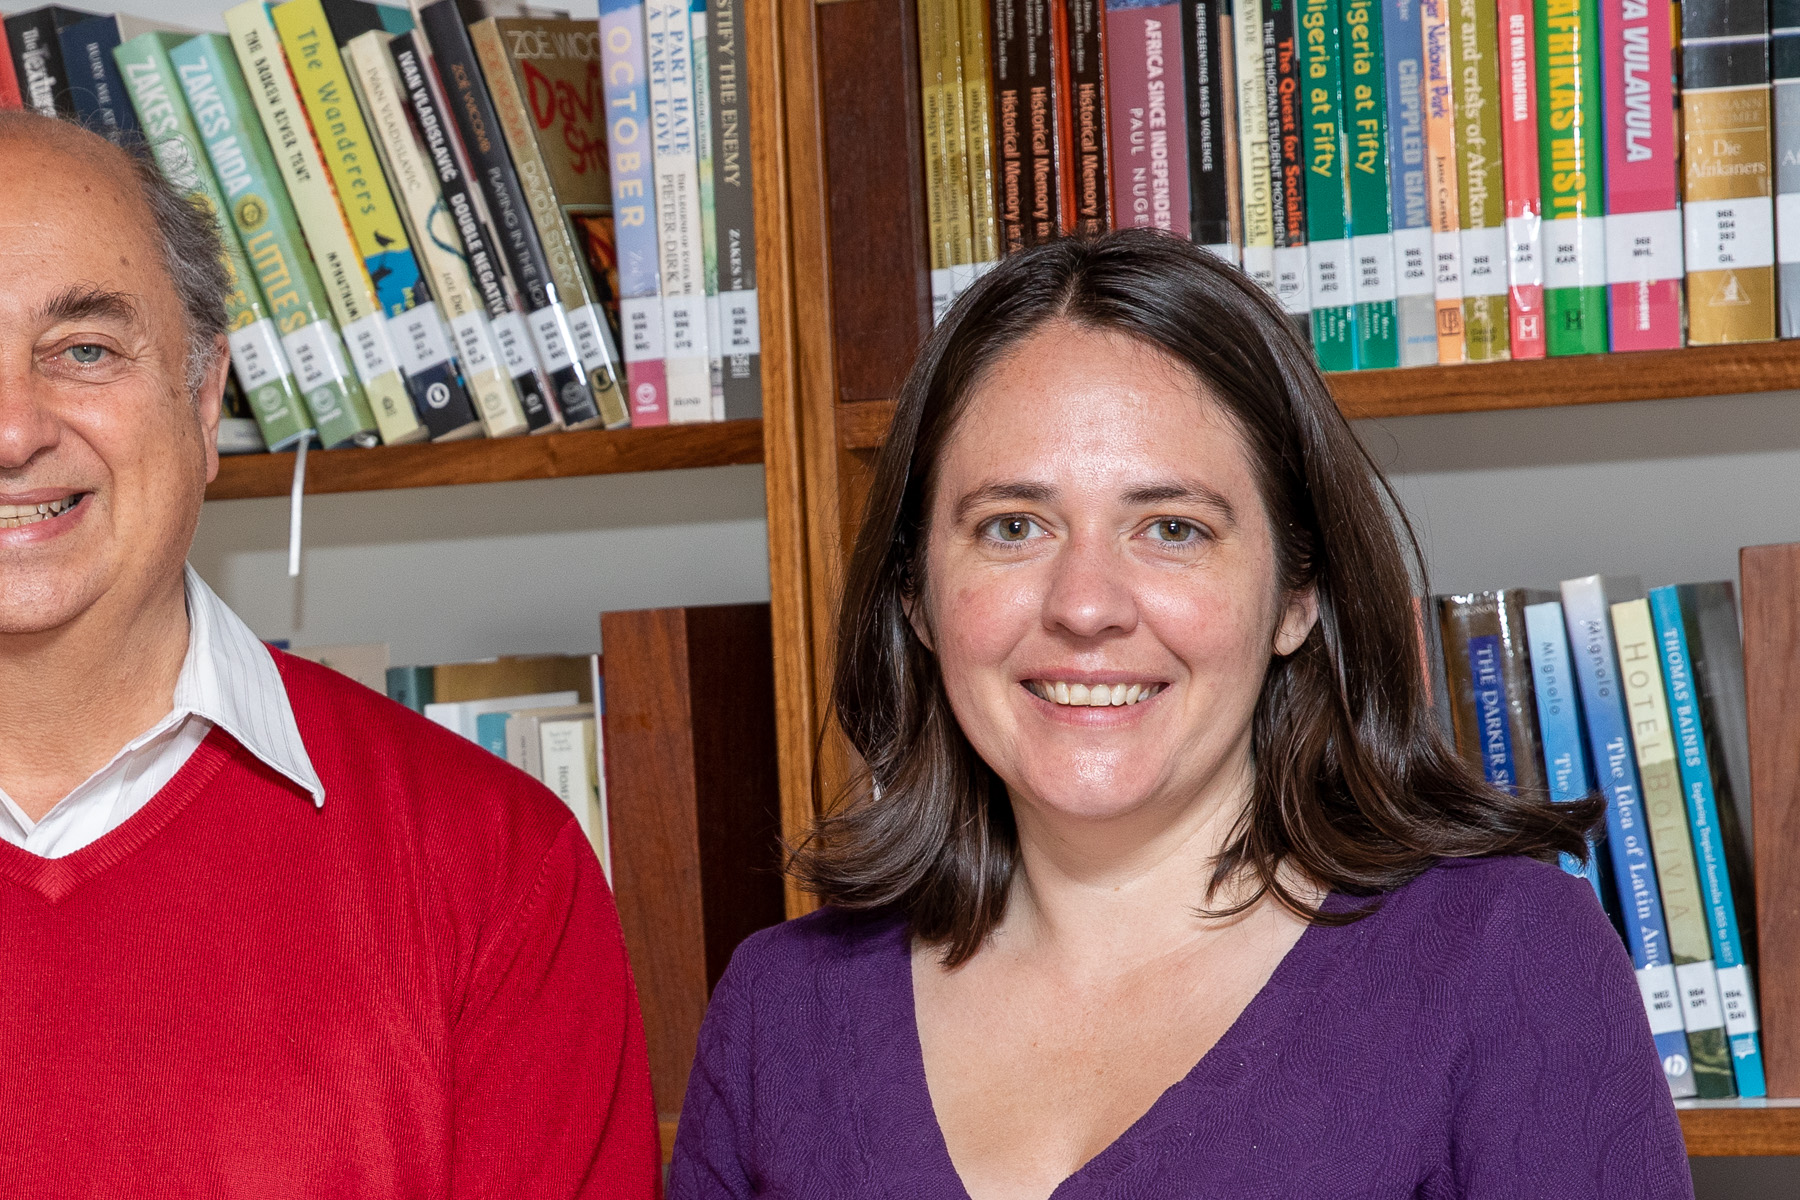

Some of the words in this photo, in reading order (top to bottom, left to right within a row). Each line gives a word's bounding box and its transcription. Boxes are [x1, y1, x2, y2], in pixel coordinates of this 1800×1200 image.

[716, 0, 735, 56] STIFY
[1145, 18, 1165, 81] AFRICA
[1196, 2, 1209, 86] REPRESENTING
[1244, 0, 1257, 46] EWDE
[1263, 19, 1276, 47] THE
[1302, 0, 1330, 79] igeria
[1346, 0, 1374, 76] igeria
[1460, 22, 1483, 62] and
[1510, 14, 1525, 36] DET
[1511, 36, 1526, 60] NYA
[650, 32, 667, 88] PART
[670, 30, 688, 86] PART
[1265, 48, 1279, 117] ETHIOPIAN
[1278, 37, 1294, 75] The
[1427, 24, 1446, 83] National
[124, 54, 179, 139] ZAKES
[245, 28, 263, 54] THE
[255, 56, 282, 106] BROKEN
[272, 108, 298, 149] RIVER
[289, 147, 313, 183] TENT
[718, 60, 737, 106] THE
[1147, 80, 1168, 130] SINCE
[1199, 86, 1211, 118] MASS
[1279, 76, 1297, 133] Quest
[1310, 88, 1332, 116] at
[1354, 84, 1376, 113] at
[1398, 58, 1422, 165] CRIPPLED
[1430, 85, 1449, 119] Park
[1463, 65, 1487, 120] crisis
[1512, 59, 1528, 122] SYDAFRIKA
[1622, 26, 1653, 163] VULAVULA
[179, 56, 231, 139] ZAKES
[211, 135, 252, 198] MDA
[296, 26, 323, 71] The
[317, 79, 376, 216] Wanderers
[606, 25, 646, 228] OCTOBER
[654, 99, 671, 158] LOVE
[673, 97, 691, 156] HATE
[1001, 89, 1021, 159] Historical
[1030, 86, 1049, 157] Historical
[1079, 83, 1098, 153] Historical
[1129, 107, 1146, 157] PAUL
[1200, 118, 1214, 173] VIOLENCE
[1354, 118, 1379, 175] Fifty
[1465, 123, 1487, 147] of
[399, 49, 421, 90] IVAN
[451, 191, 484, 252] DOUBLE
[720, 109, 741, 188] ENEMY
[1269, 118, 1282, 178] STUDENT
[1283, 134, 1300, 163] for
[1311, 122, 1336, 178] Fifty
[1435, 155, 1447, 185] Jane
[1688, 158, 1767, 178] Afrikaners
[1712, 138, 1742, 157] Die
[488, 166, 519, 229] PLAYING
[1004, 160, 1022, 222] Memory
[1033, 158, 1050, 220] Memory
[1081, 154, 1098, 217] Memory
[1132, 167, 1150, 225] NUGE
[1151, 130, 1172, 231] INDEPENDEN
[1251, 140, 1272, 237] Ethiopia
[1284, 164, 1302, 241] Socialist
[1403, 170, 1425, 227] GIAN
[509, 229, 526, 250] IN
[662, 173, 680, 283] PIETER-DIRK
[728, 228, 742, 281] ZAKES
[247, 230, 300, 315] LITTLE
[516, 248, 537, 278] THE
[546, 228, 576, 290] STORY
[526, 274, 548, 307] LIG
[1476, 643, 1497, 686] THE
[1586, 619, 1610, 698] Mignolo
[1663, 626, 1690, 702] THOMAS
[1482, 689, 1507, 768] DARKER
[1540, 641, 1561, 716] Mignolo
[1554, 752, 1574, 793] The
[1676, 704, 1702, 768] BAINES
[1606, 736, 1626, 779] The
[1623, 640, 1661, 759] HOTEL
[1647, 771, 1690, 922] BOLIVIA
[1614, 784, 1635, 831] Idea
[1691, 781, 1708, 828] Exploring
[1624, 835, 1645, 857] of
[1628, 863, 1654, 920] Latin
